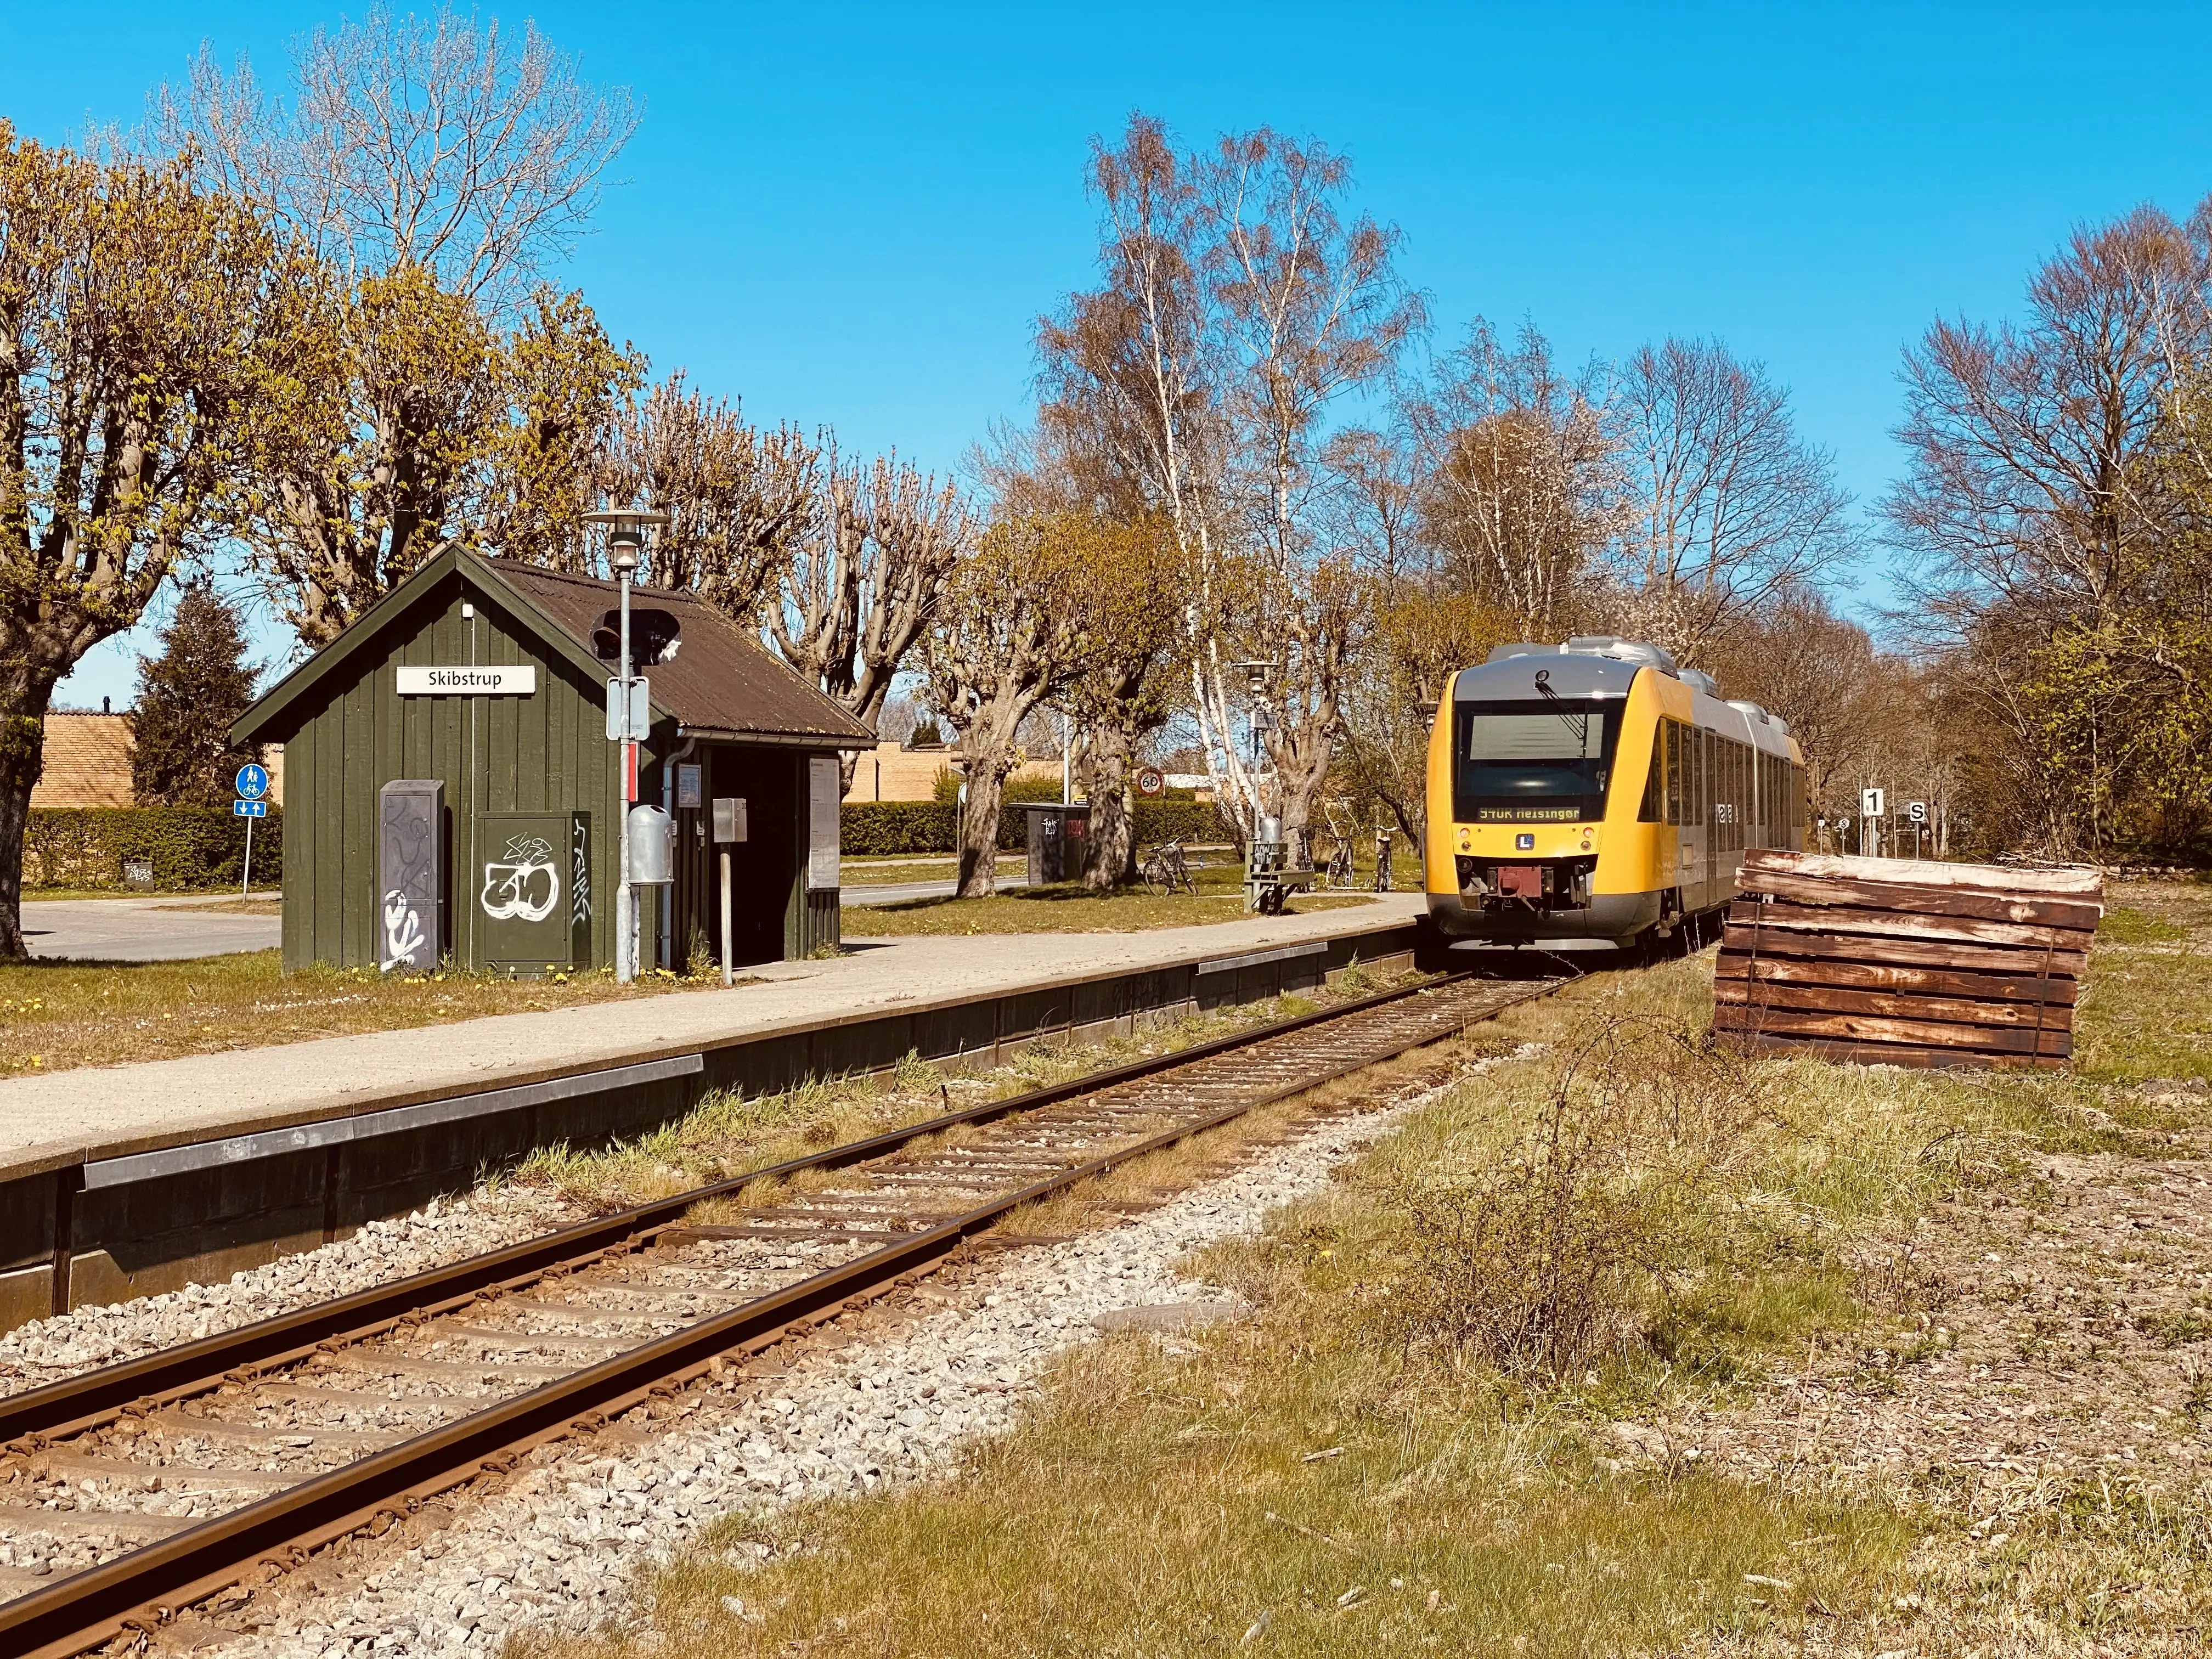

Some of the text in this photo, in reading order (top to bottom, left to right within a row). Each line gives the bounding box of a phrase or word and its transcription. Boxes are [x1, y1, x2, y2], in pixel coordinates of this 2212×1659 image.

[429, 670, 501, 689] Skibstrup
[1142, 776, 1158, 787] 60
[1867, 792, 1877, 812] 1
[1911, 804, 1923, 819] S
[1520, 836, 1530, 848] L
